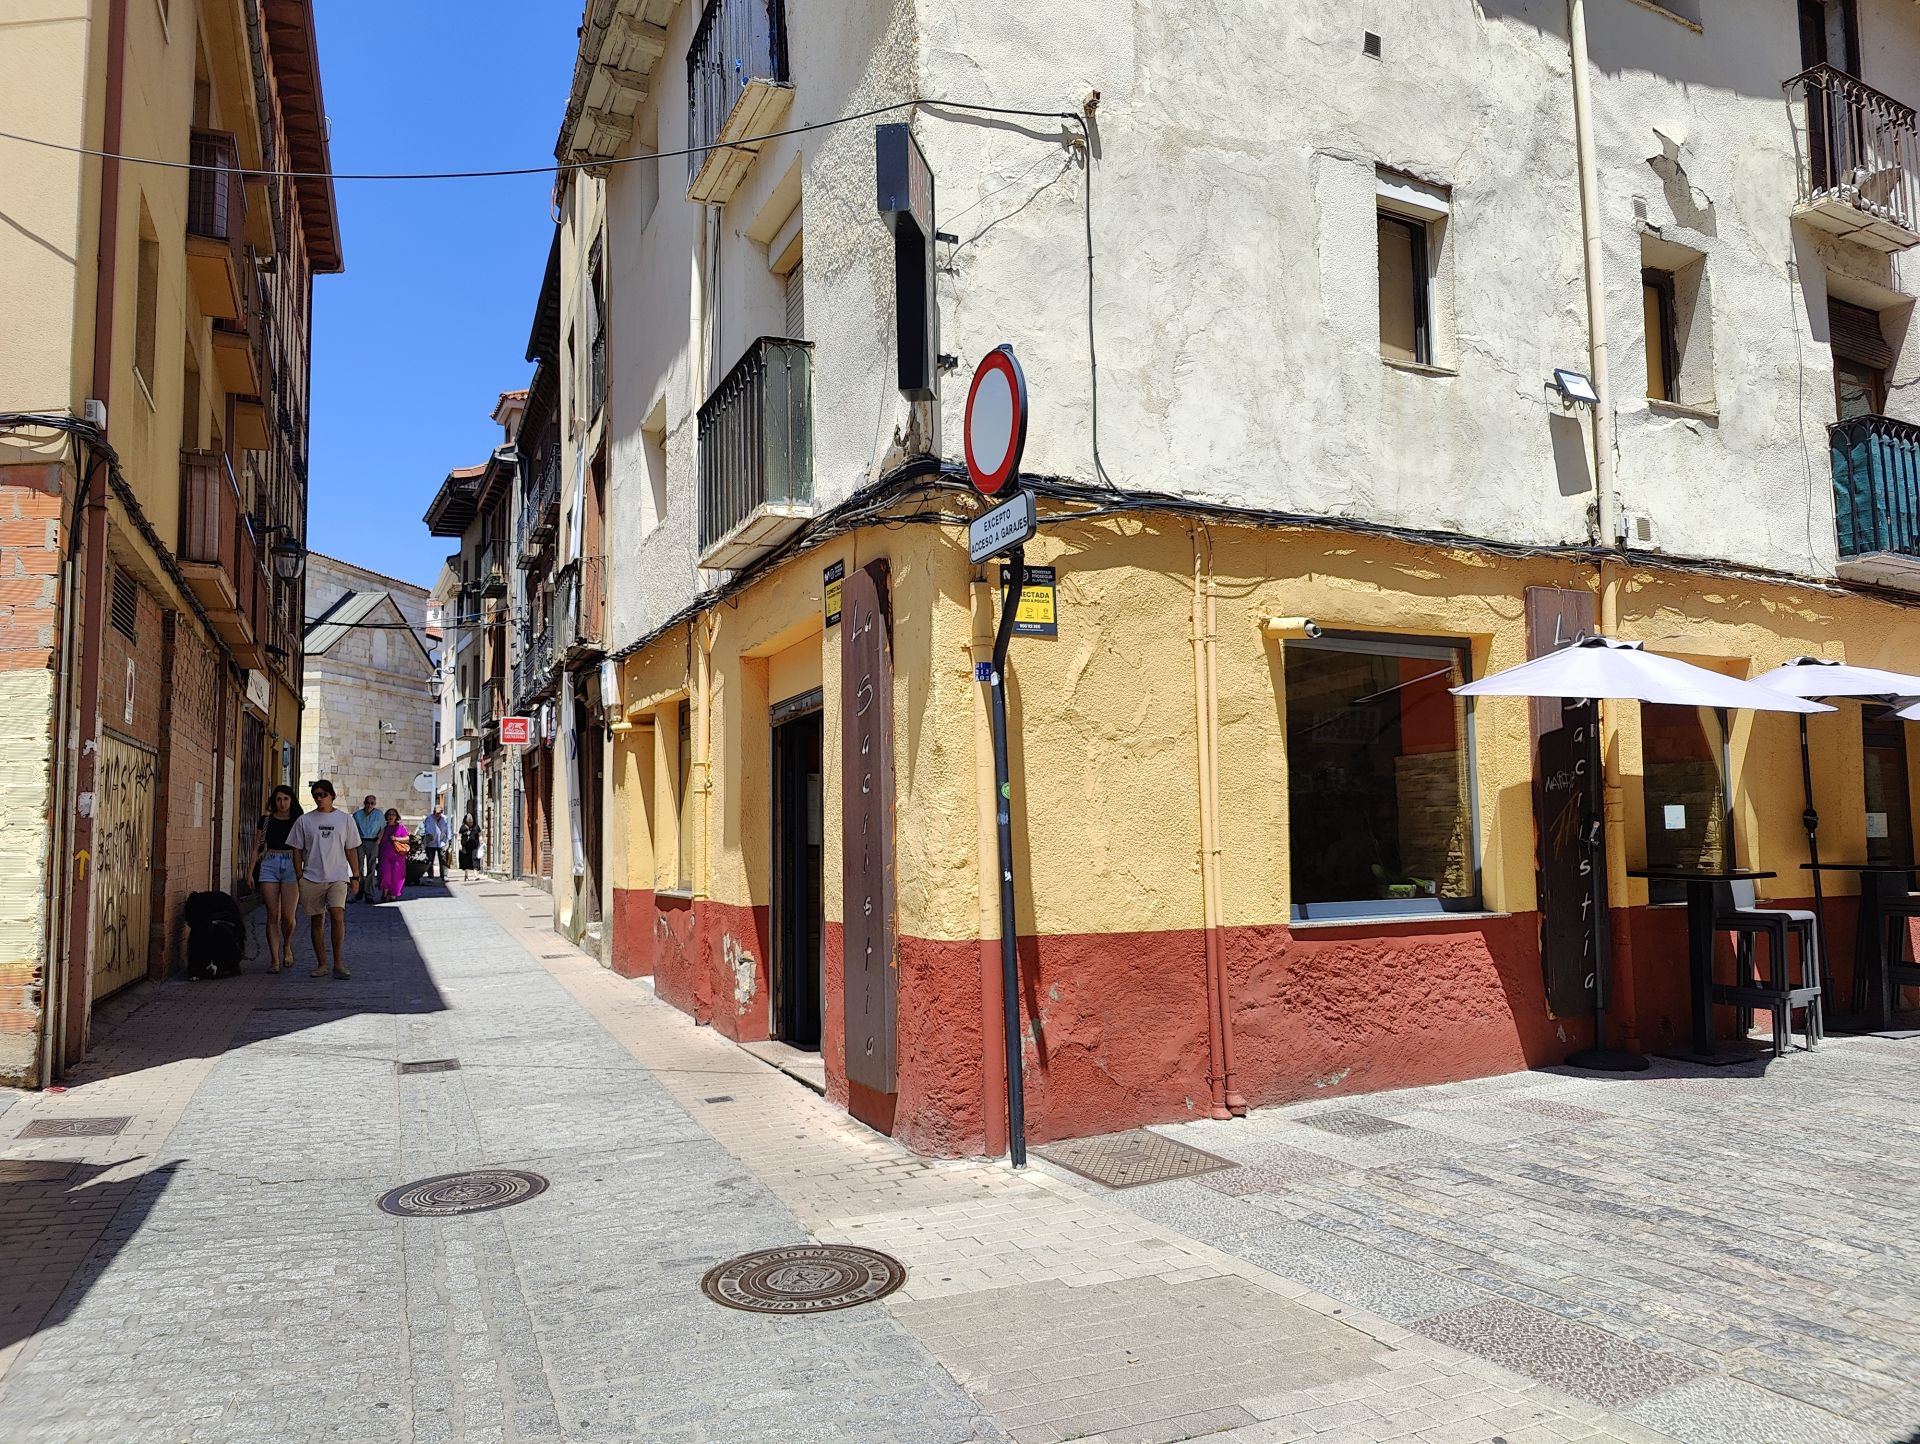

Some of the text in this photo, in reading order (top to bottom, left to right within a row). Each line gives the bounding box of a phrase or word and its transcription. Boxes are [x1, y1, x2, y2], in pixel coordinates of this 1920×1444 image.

[983, 508, 1011, 532] EXCEPTO
[971, 516, 1028, 554] ACCESO A GARAJES
[1019, 591, 1050, 599] ECTADA
